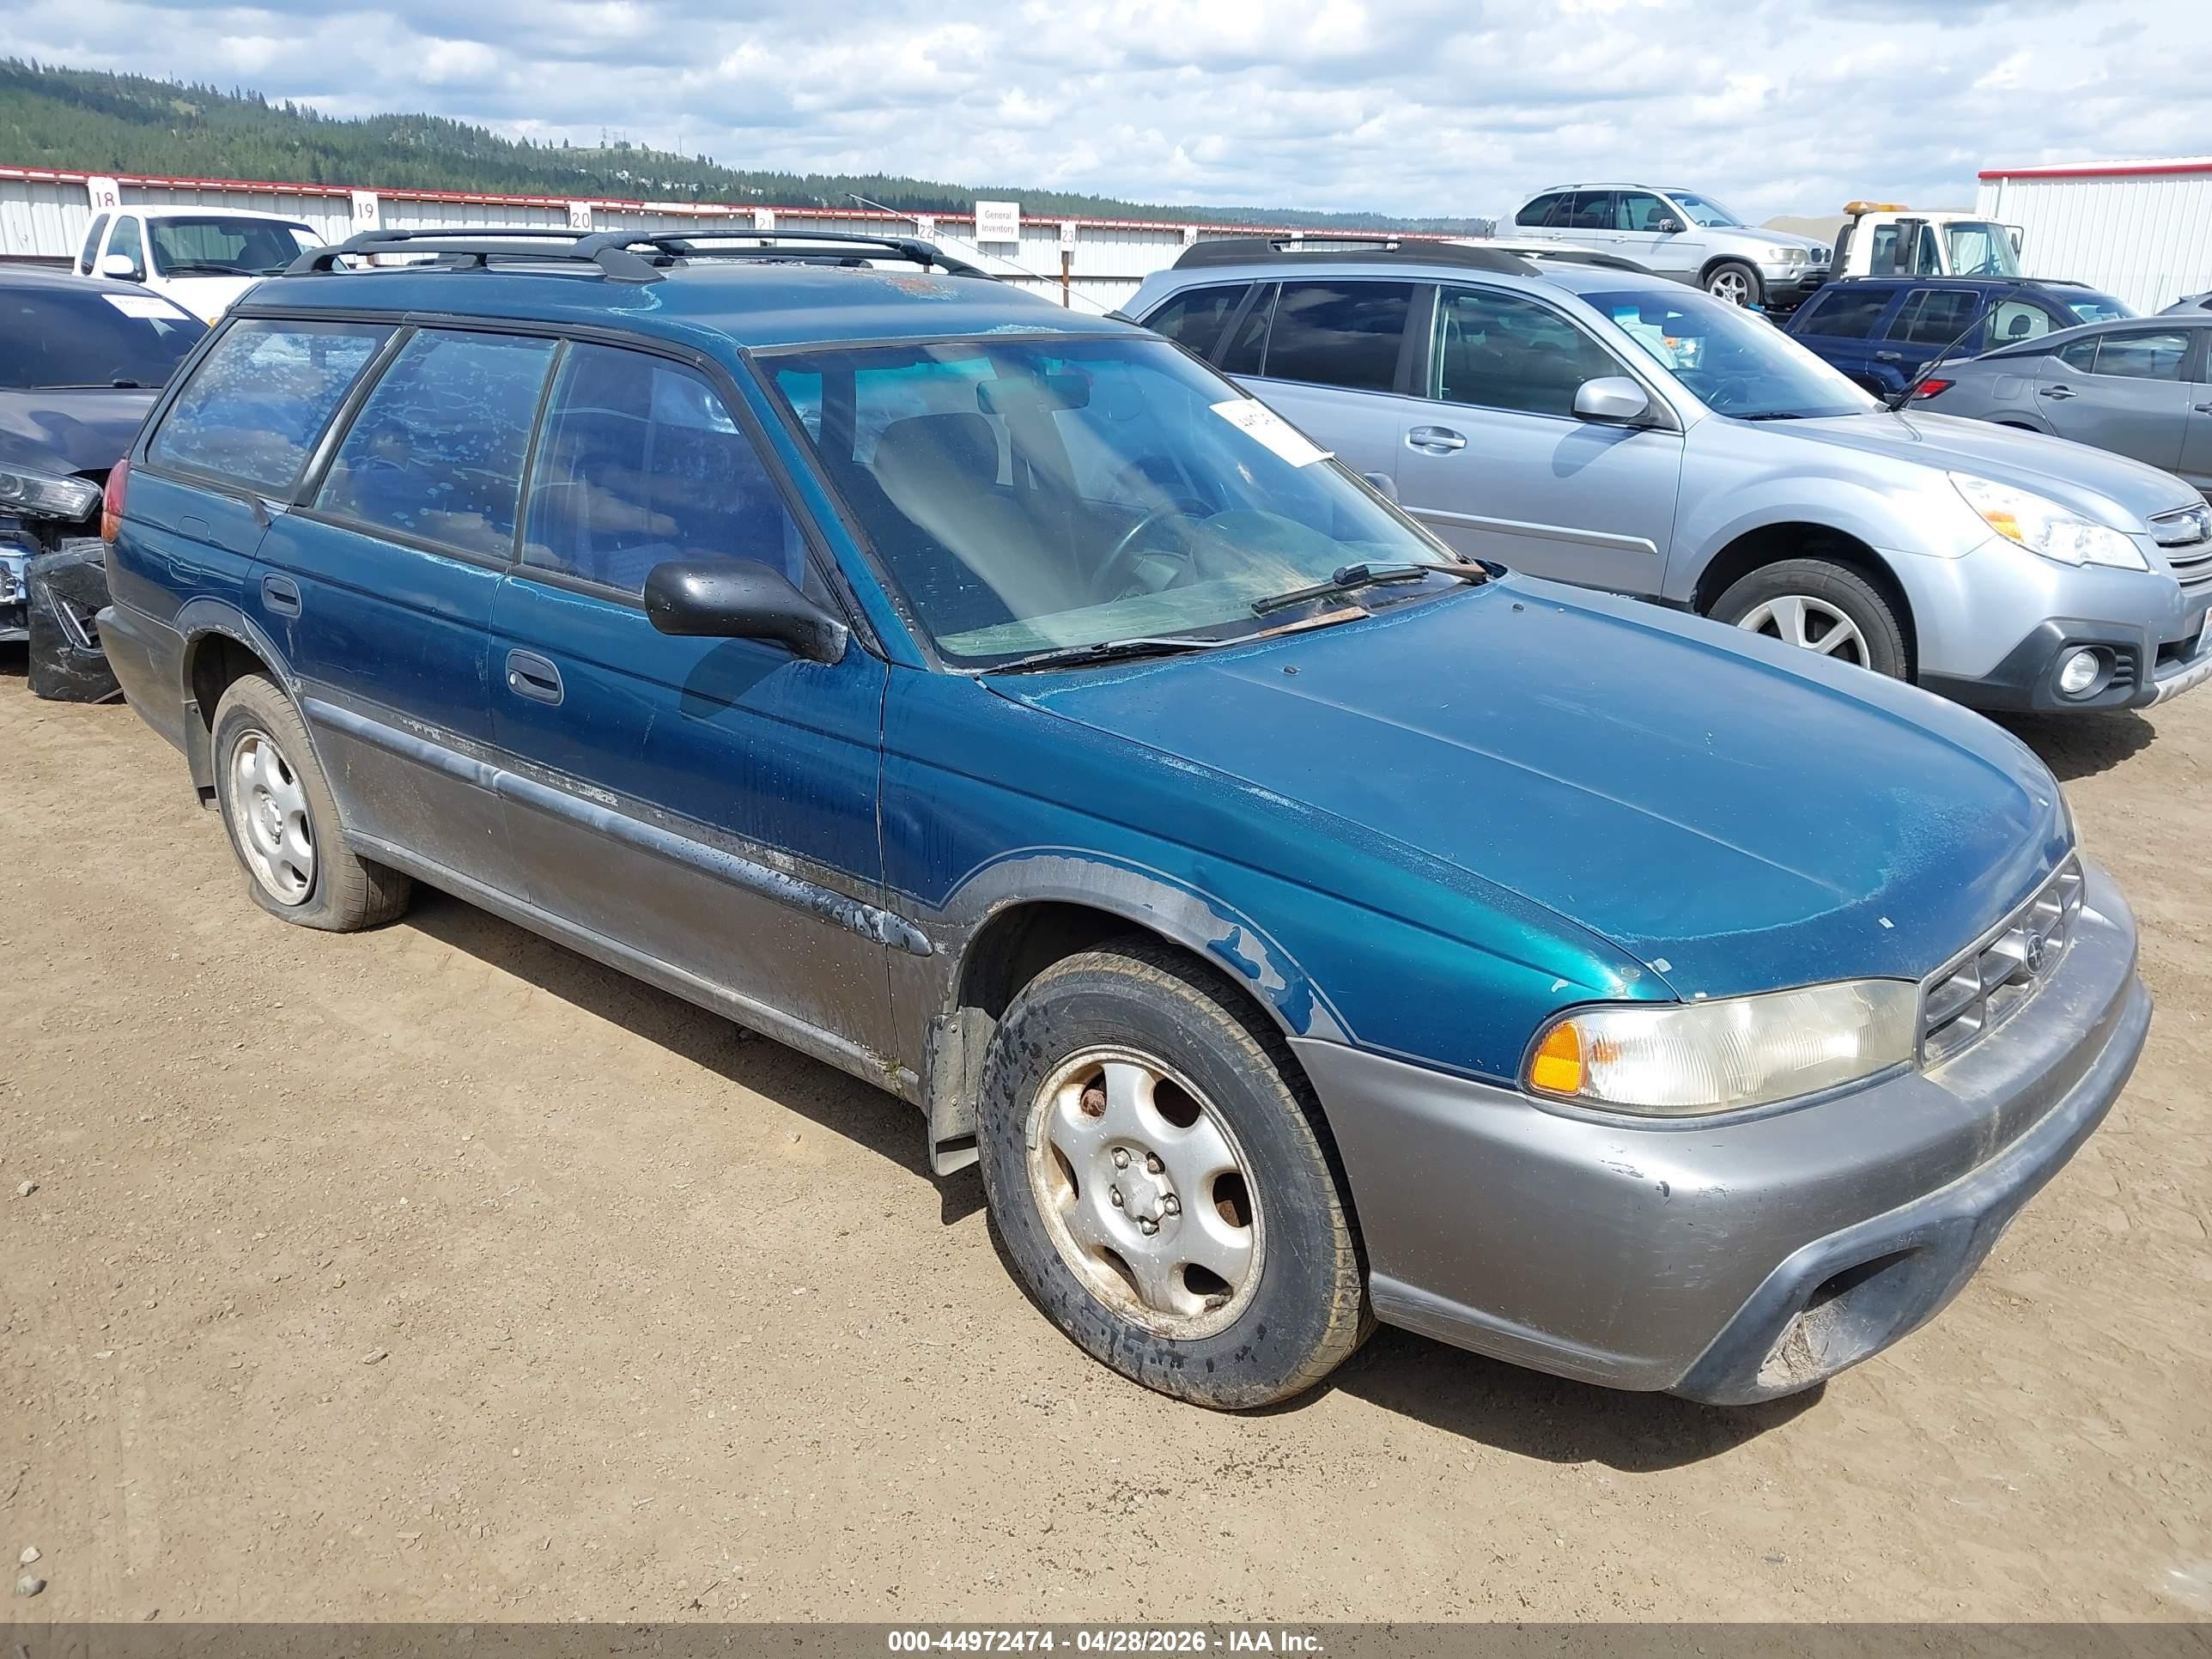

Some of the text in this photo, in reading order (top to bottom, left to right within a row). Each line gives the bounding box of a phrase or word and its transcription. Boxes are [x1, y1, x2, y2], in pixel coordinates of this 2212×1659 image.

[95, 191, 115, 207] 18
[358, 203, 374, 219] 19
[984, 210, 1012, 221] General
[572, 212, 590, 228] 20
[920, 223, 933, 239] 22
[981, 223, 1014, 234] Inventory
[1062, 229, 1073, 243] 23
[1185, 234, 1195, 246] 24
